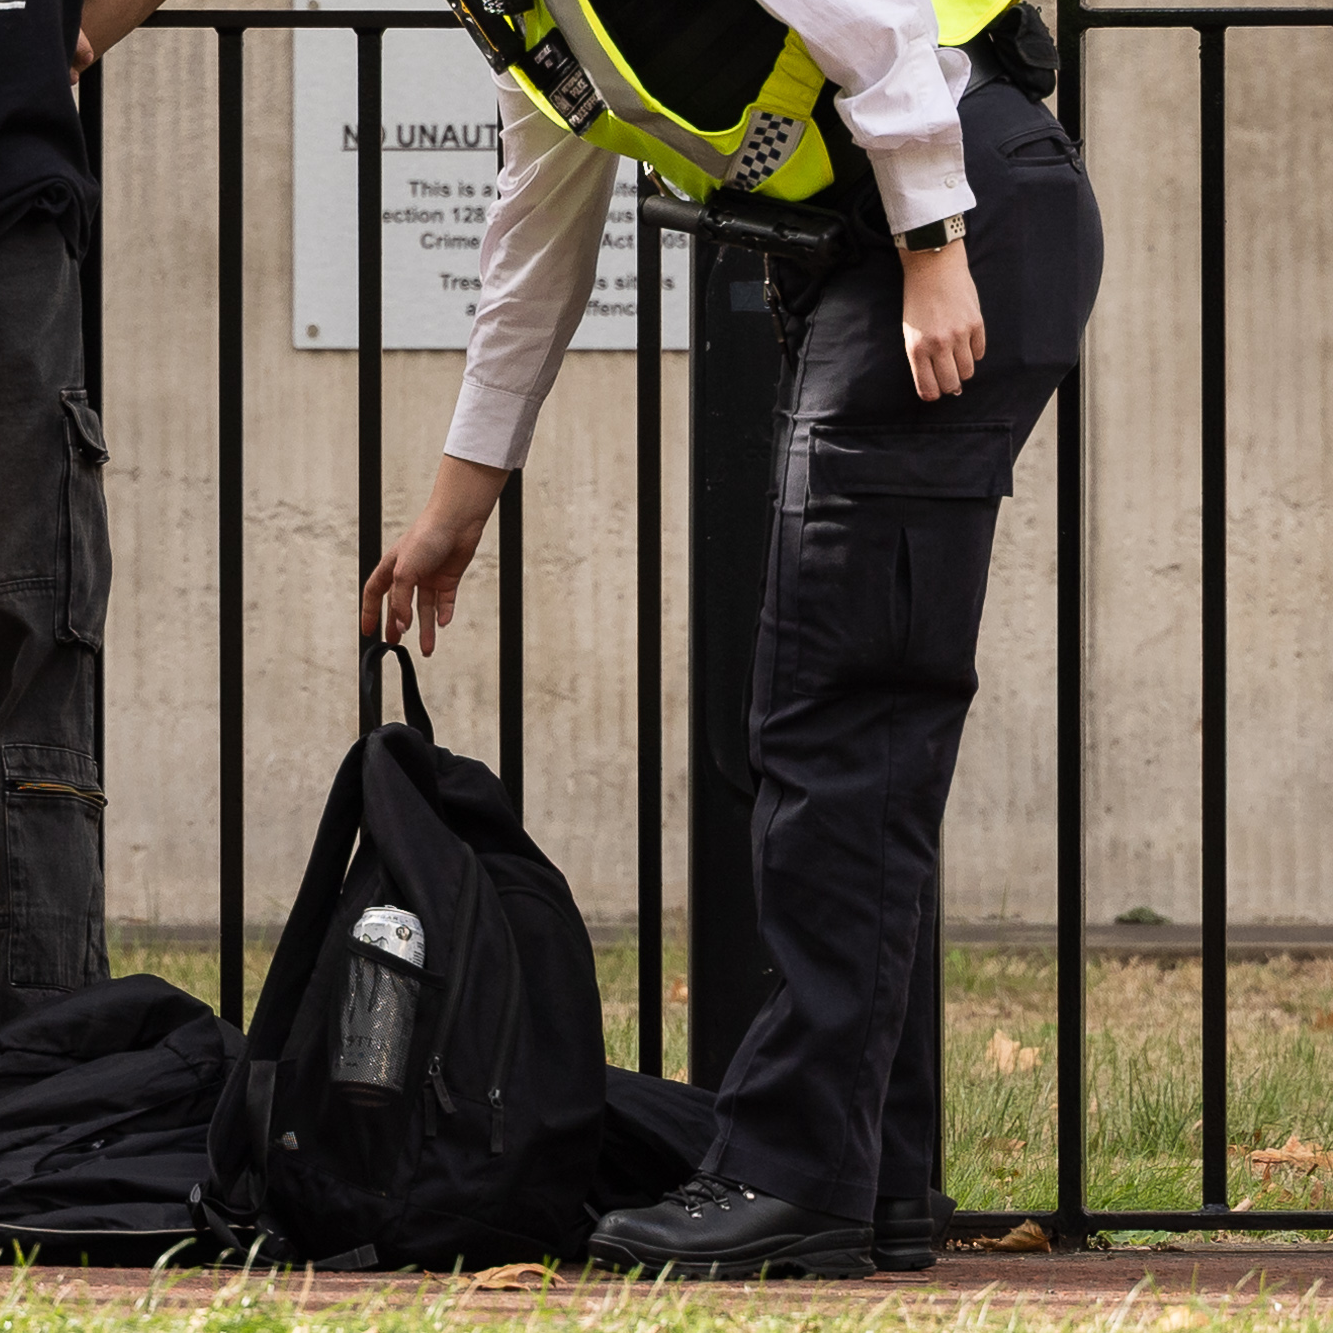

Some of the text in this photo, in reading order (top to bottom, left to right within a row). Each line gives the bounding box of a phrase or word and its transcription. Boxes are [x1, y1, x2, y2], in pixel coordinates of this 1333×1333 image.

[397, 124, 498, 148] UNAUT
[409, 180, 452, 198] This
[458, 180, 475, 198] is
[481, 185, 494, 198] a
[383, 207, 486, 224] ection 128
[420, 233, 481, 250] Crime
[601, 233, 635, 249] Act
[440, 273, 483, 291] Tres
